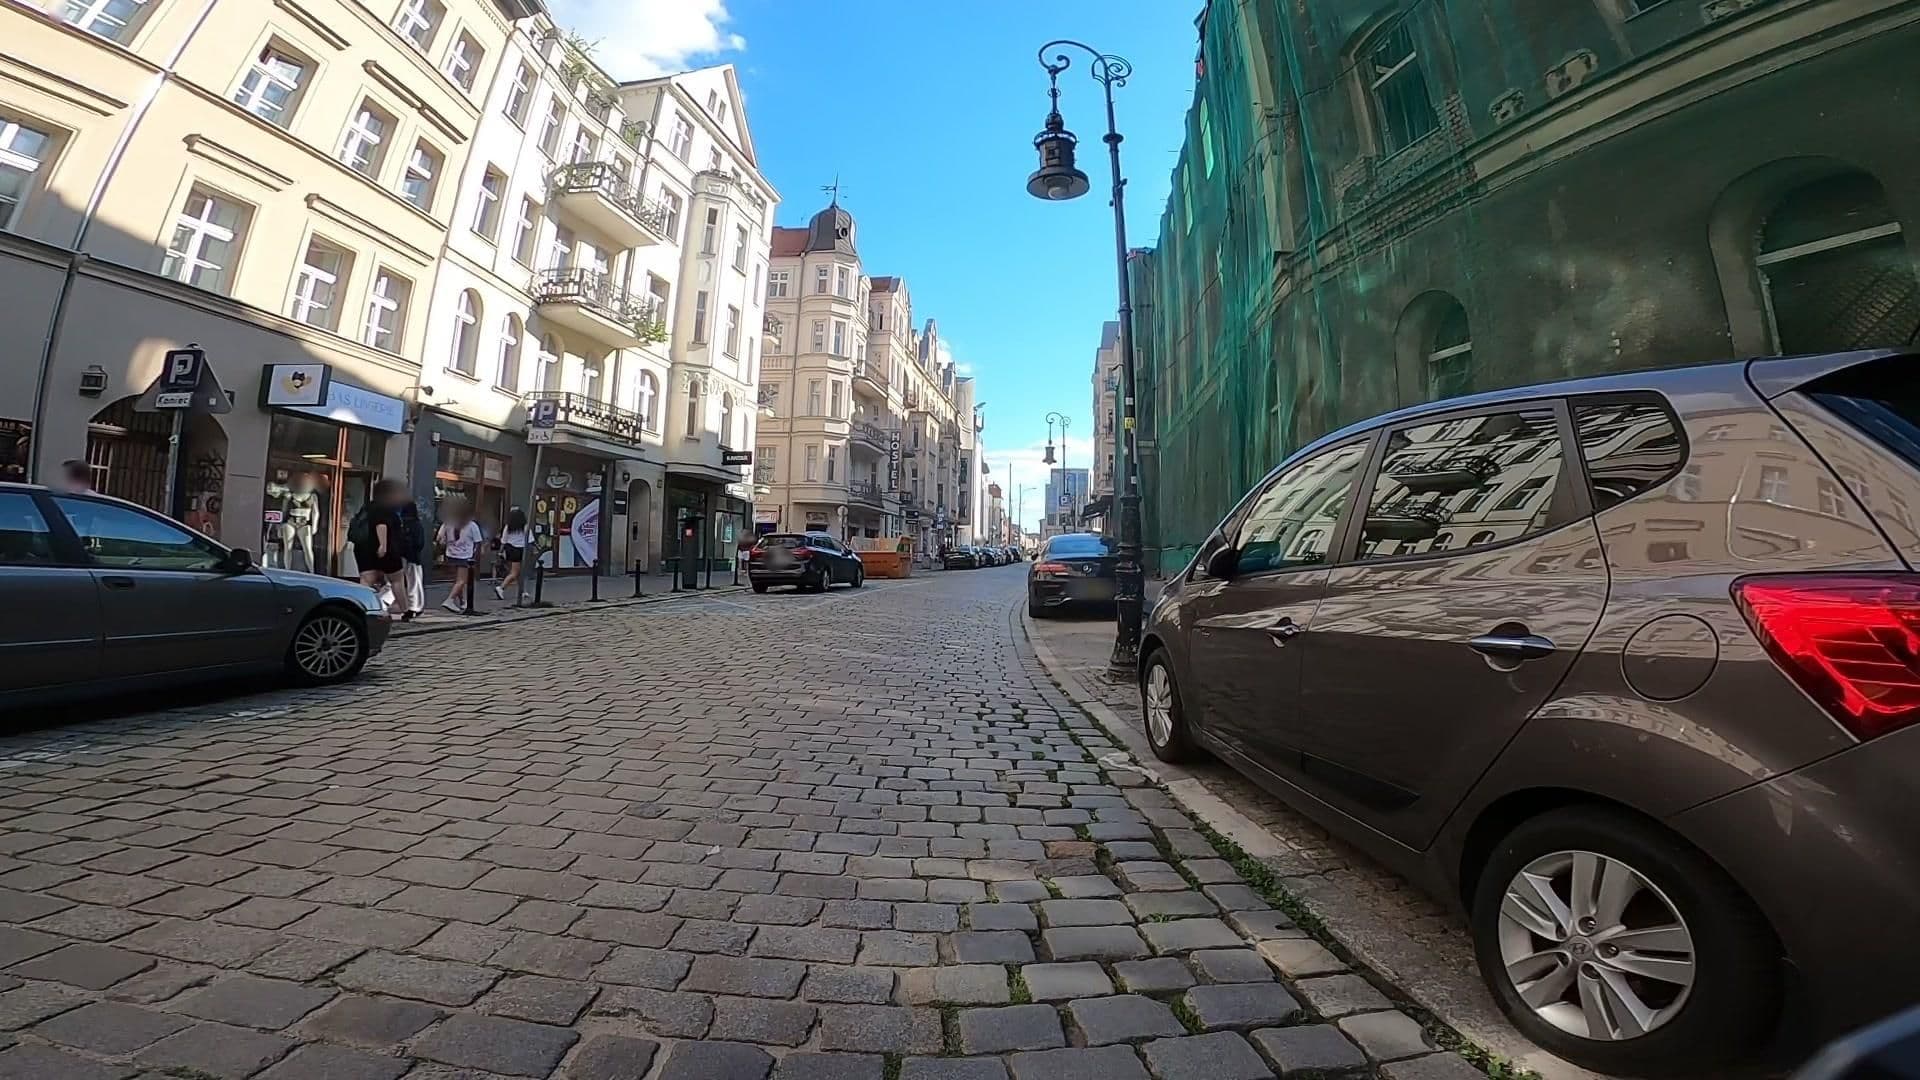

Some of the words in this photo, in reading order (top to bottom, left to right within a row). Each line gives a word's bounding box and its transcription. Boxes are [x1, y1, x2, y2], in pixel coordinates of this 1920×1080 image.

[169, 354, 193, 383] P
[158, 395, 190, 405] Koniec
[538, 402, 554, 420] P
[890, 432, 900, 489] HOSTEL
